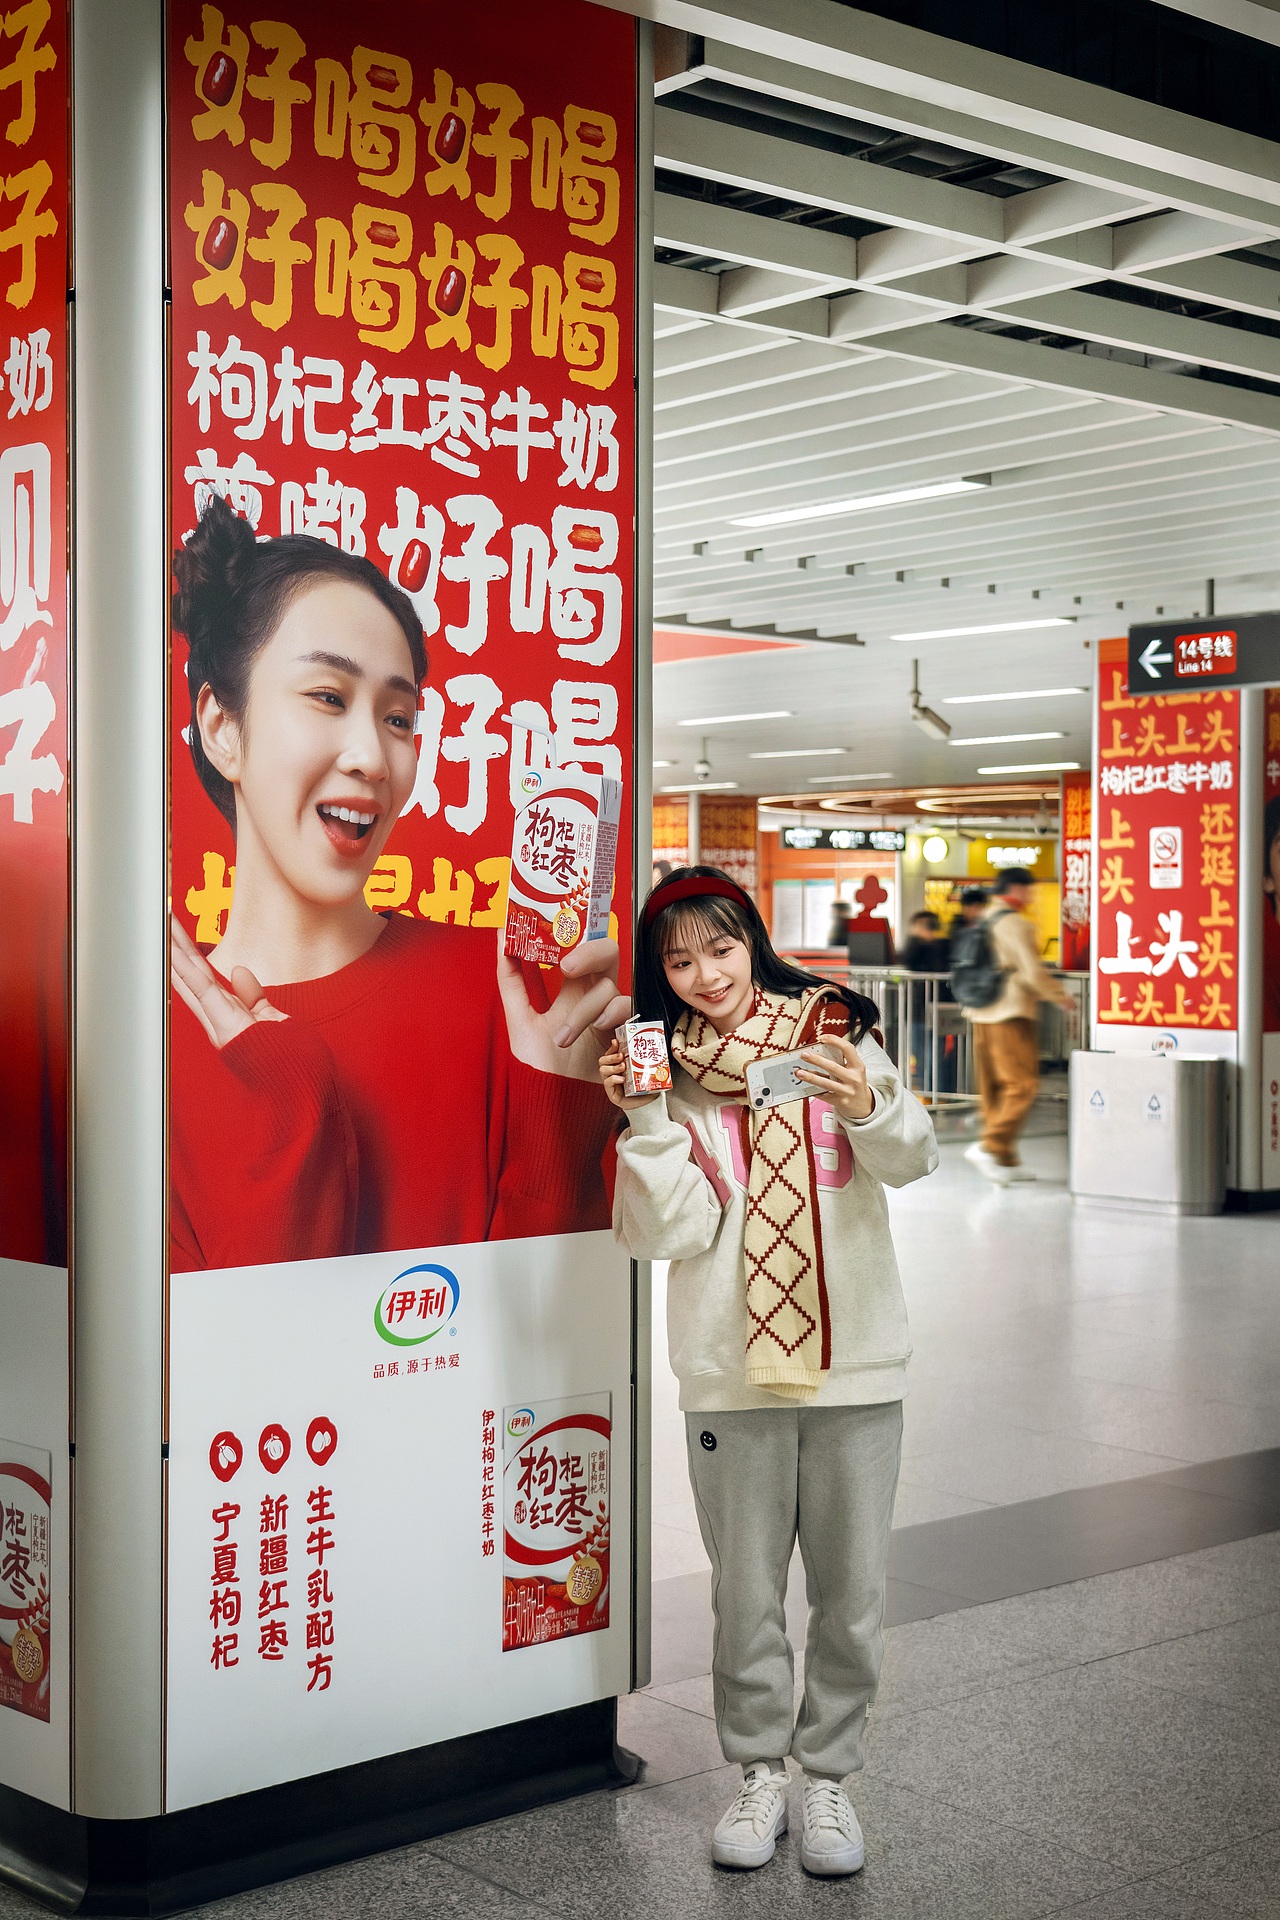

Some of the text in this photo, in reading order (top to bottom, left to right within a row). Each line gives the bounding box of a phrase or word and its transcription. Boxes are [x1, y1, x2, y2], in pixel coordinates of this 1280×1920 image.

[184, 5, 620, 245] 好喝好喝
[184, 168, 620, 391] 好喝好喝
[187, 330, 620, 492] 枸杞红枣牛奶
[1178, 635, 1233, 659] 14号线
[1178, 660, 1213, 674] Line 14
[1101, 709, 1233, 759] 上头上头
[1101, 760, 1233, 796] 枸杞红枣牛奶
[525, 804, 575, 848] 枸杞
[532, 844, 579, 888] 红枣
[1099, 807, 1135, 904] 上头
[1198, 803, 1235, 979] 还挺上头
[1098, 909, 1199, 979] 上头
[1099, 980, 1232, 1027] 上头上头
[386, 1286, 447, 1324] 伊利
[511, 1416, 531, 1430] 伊利
[481, 1409, 495, 1557] 伊利枸杞红枣牛奶
[517, 1446, 584, 1500] 枸杞
[529, 1482, 594, 1535] 红枣
[209, 1502, 241, 1670] 宁夏枸杞
[258, 1493, 289, 1660] 新疆红枣
[306, 1485, 335, 1692] 生牛乳配方
[572, 1565, 599, 1585] 生牛乳
[572, 1581, 593, 1600] 配方
